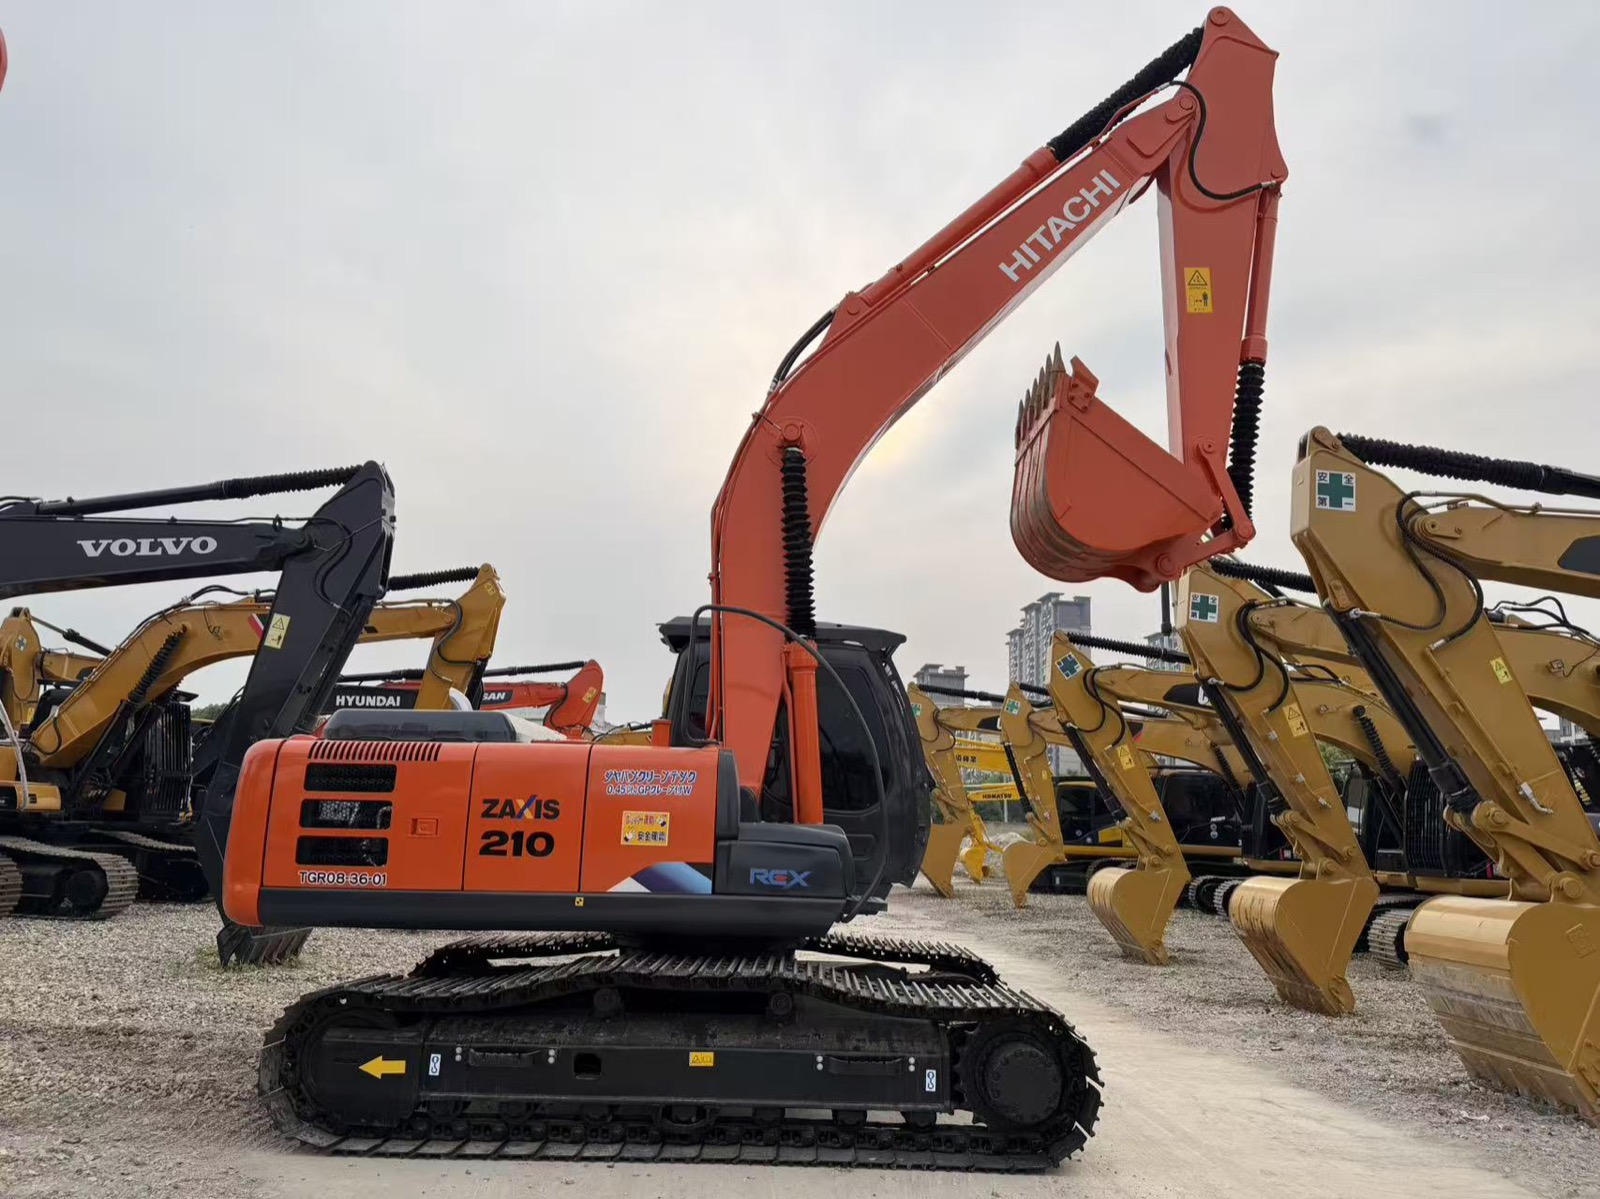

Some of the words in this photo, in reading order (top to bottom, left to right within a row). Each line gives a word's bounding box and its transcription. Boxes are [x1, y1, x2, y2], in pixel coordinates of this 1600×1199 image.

[998, 169, 1121, 282] HITACHI
[76, 536, 218, 557] VOLVO
[335, 695, 401, 707] HYUNDAI
[480, 794, 561, 820] ZAXIS
[479, 829, 555, 858] 210
[298, 870, 388, 886] TGR08-36-01
[749, 868, 812, 889] REX
